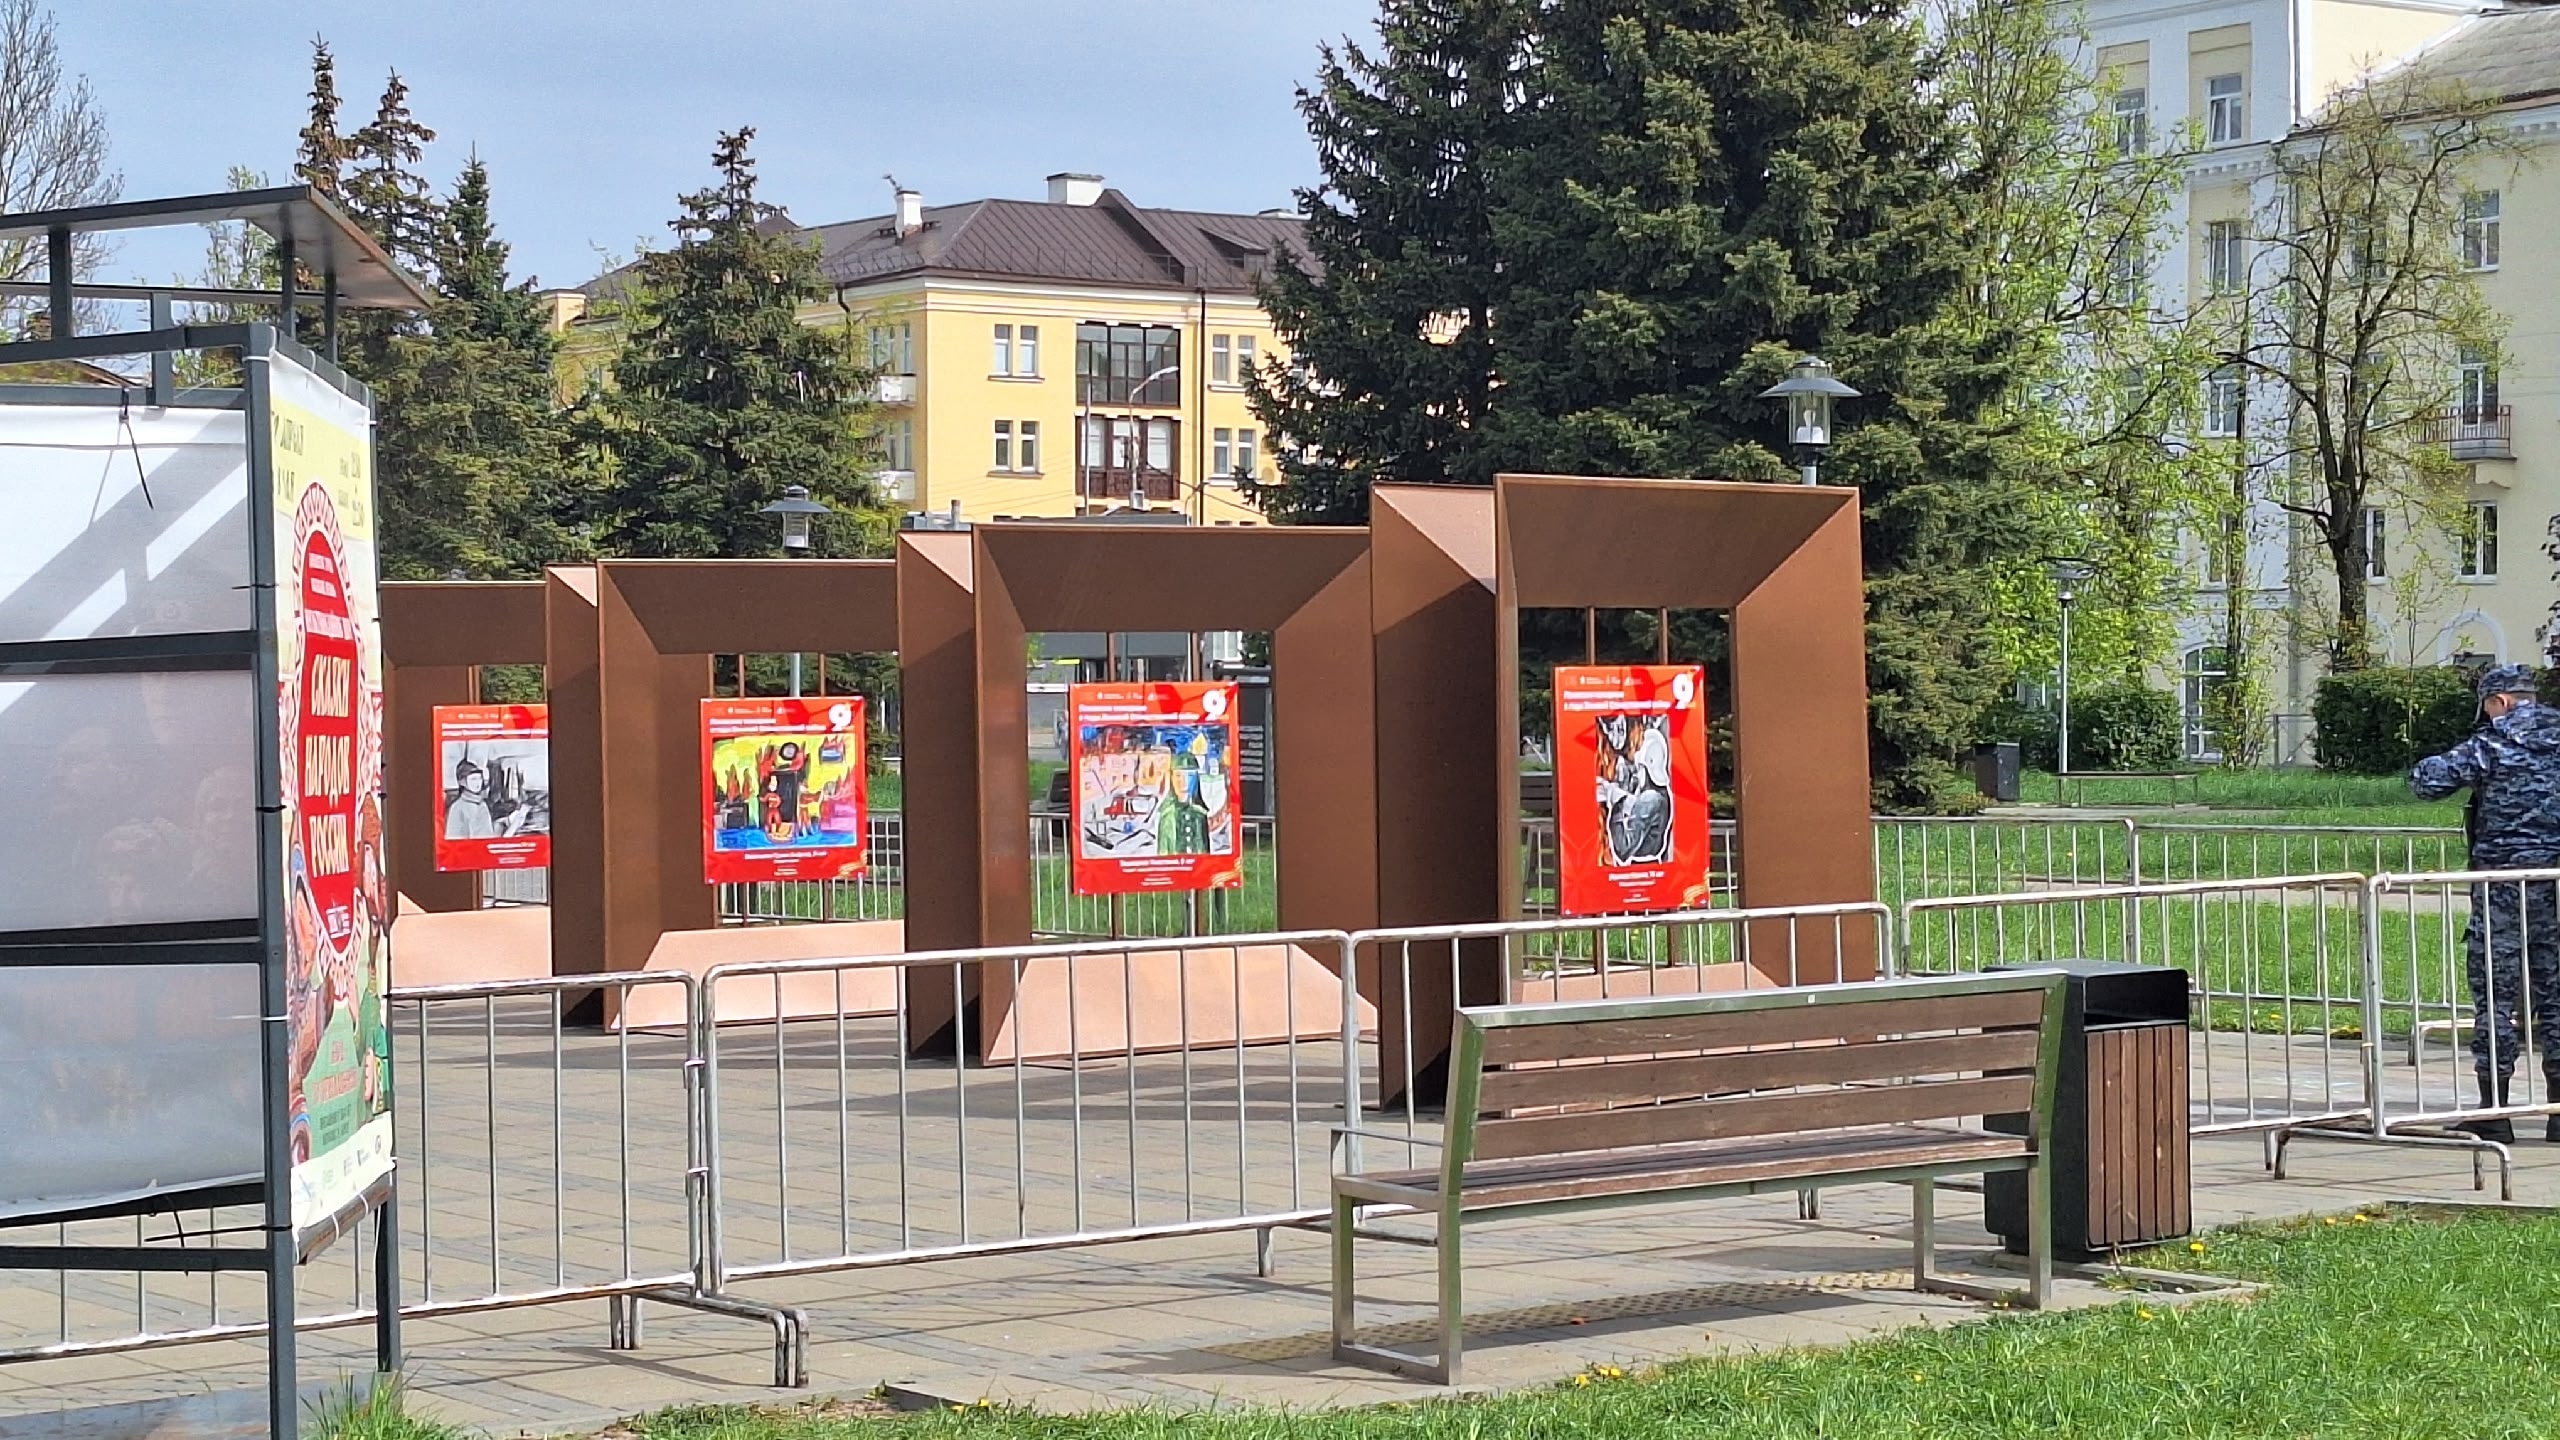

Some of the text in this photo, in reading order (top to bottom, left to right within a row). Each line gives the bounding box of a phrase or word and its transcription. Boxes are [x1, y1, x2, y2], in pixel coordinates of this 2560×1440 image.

[311, 654, 351, 718] СКАЗКИ
[304, 734, 351, 808] НАРОДОВ
[308, 813, 350, 878] РОССИИ
